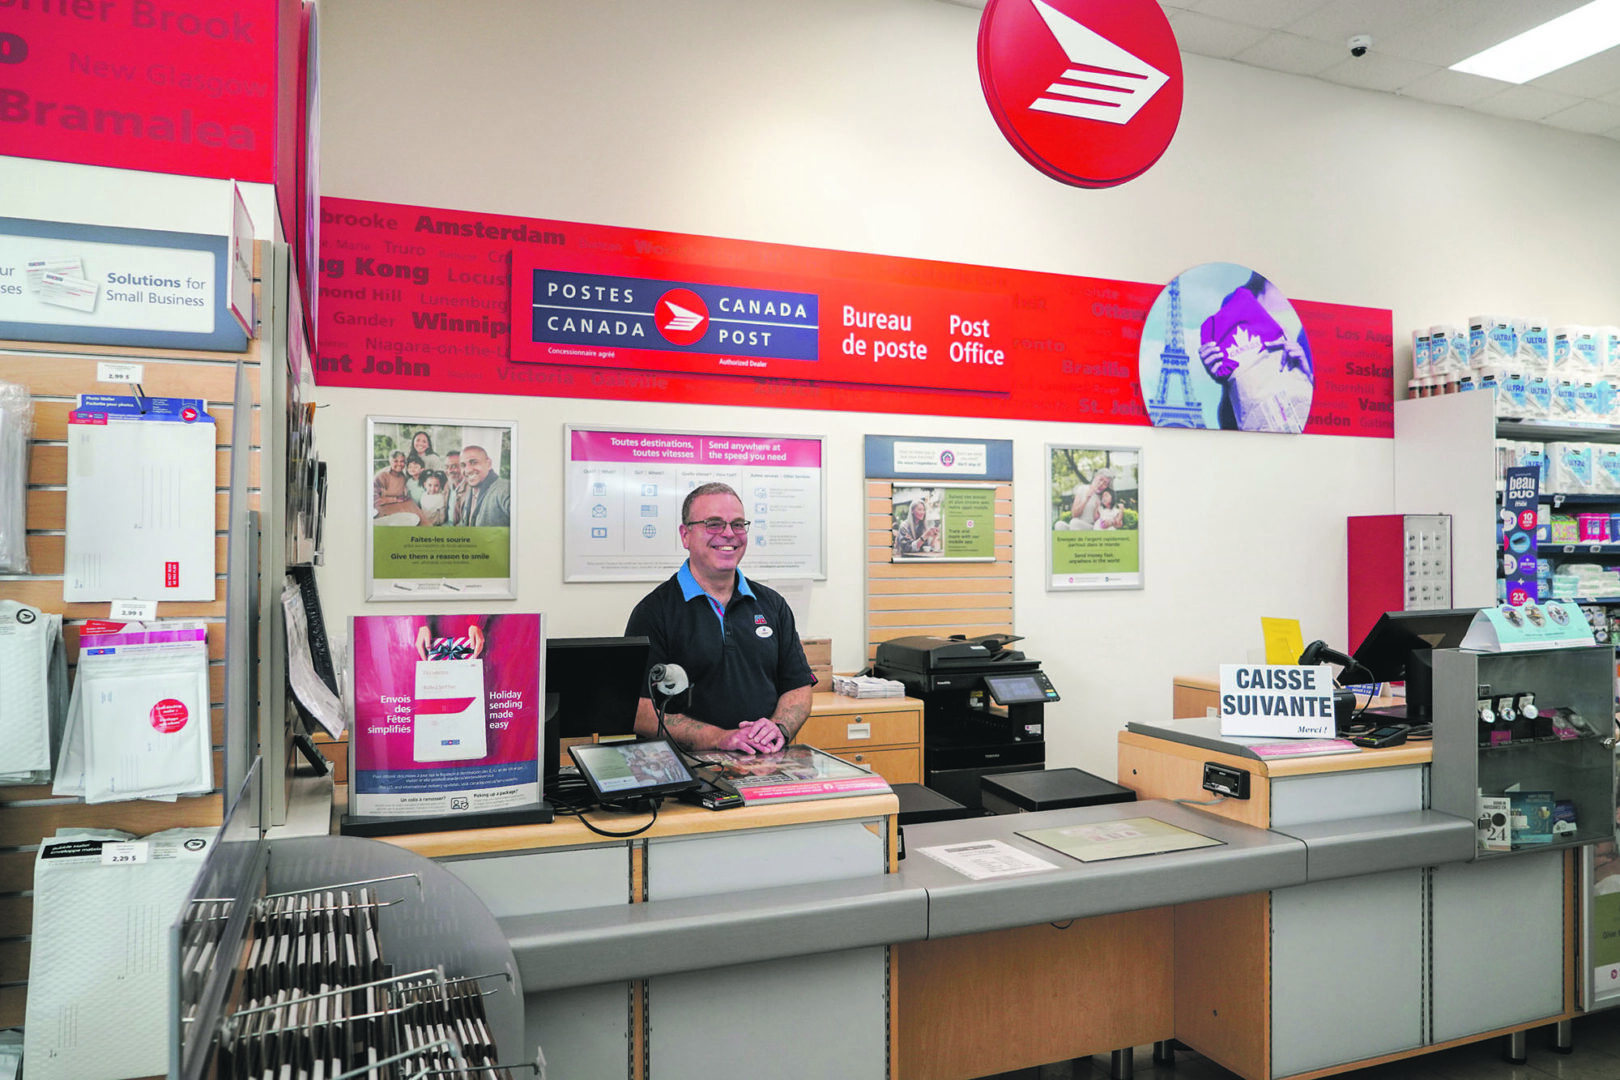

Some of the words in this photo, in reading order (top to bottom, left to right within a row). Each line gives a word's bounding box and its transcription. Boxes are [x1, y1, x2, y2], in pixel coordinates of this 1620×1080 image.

[132, 0, 255, 43] Brook
[69, 52, 135, 81] New
[147, 63, 268, 98] Glasgow
[0, 88, 256, 150] Bramalea
[320, 208, 398, 230] brooke
[415, 215, 565, 246] Amsterdam
[384, 241, 427, 256] Truro
[356, 257, 429, 285] Kong
[107, 272, 181, 288] Solutions
[186, 277, 206, 290] for
[0, 285, 22, 295] ses
[548, 282, 634, 304] POSTES
[106, 290, 145, 303] Small
[148, 292, 205, 307] Business
[373, 289, 402, 302] Hill
[421, 292, 508, 313] Lunenburg
[719, 297, 807, 319] CANADA
[333, 311, 396, 328] Gander
[843, 305, 912, 331] Bureau
[547, 316, 645, 337] CANADA
[949, 315, 990, 337] Post
[719, 329, 772, 346] POST
[1336, 327, 1361, 341] Los
[1365, 330, 1393, 348] Ang
[1493, 333, 1511, 341] ULTRA
[548, 346, 597, 358] Concessionnaire
[598, 350, 615, 358] agréé
[842, 332, 867, 356] de
[873, 338, 928, 363] poste
[949, 341, 1005, 365] Office
[719, 358, 749, 368] Authorized
[749, 360, 767, 368] Dealer
[363, 355, 430, 377] John
[496, 366, 574, 385] Victoria
[590, 371, 669, 389] Oakville
[1325, 380, 1375, 395] Thornhill
[1079, 398, 1104, 414] St.
[611, 438, 639, 447] Toutes
[640, 438, 694, 449] destinations,
[708, 440, 730, 451] Send
[731, 441, 771, 452] anywhere
[772, 443, 781, 451] at
[633, 449, 660, 457] toutes
[661, 449, 694, 458] vitesses
[708, 451, 723, 460] the
[724, 452, 748, 462] speed
[749, 454, 765, 463] you
[766, 452, 787, 461] need
[1509, 477, 1535, 490] beau
[1509, 490, 1535, 499] DUO
[1513, 592, 1525, 601] 2X
[1236, 668, 1316, 690] CAISSE
[381, 695, 411, 704] Envois
[489, 690, 522, 701] Holiday
[394, 704, 411, 713] des
[489, 700, 523, 710] sending
[1222, 694, 1332, 717] SUIVANTE
[386, 715, 411, 723] Fêtes
[489, 710, 514, 719] made
[367, 725, 411, 735] simplifiés
[489, 721, 509, 730] easy
[1487, 828, 1506, 840] 24
